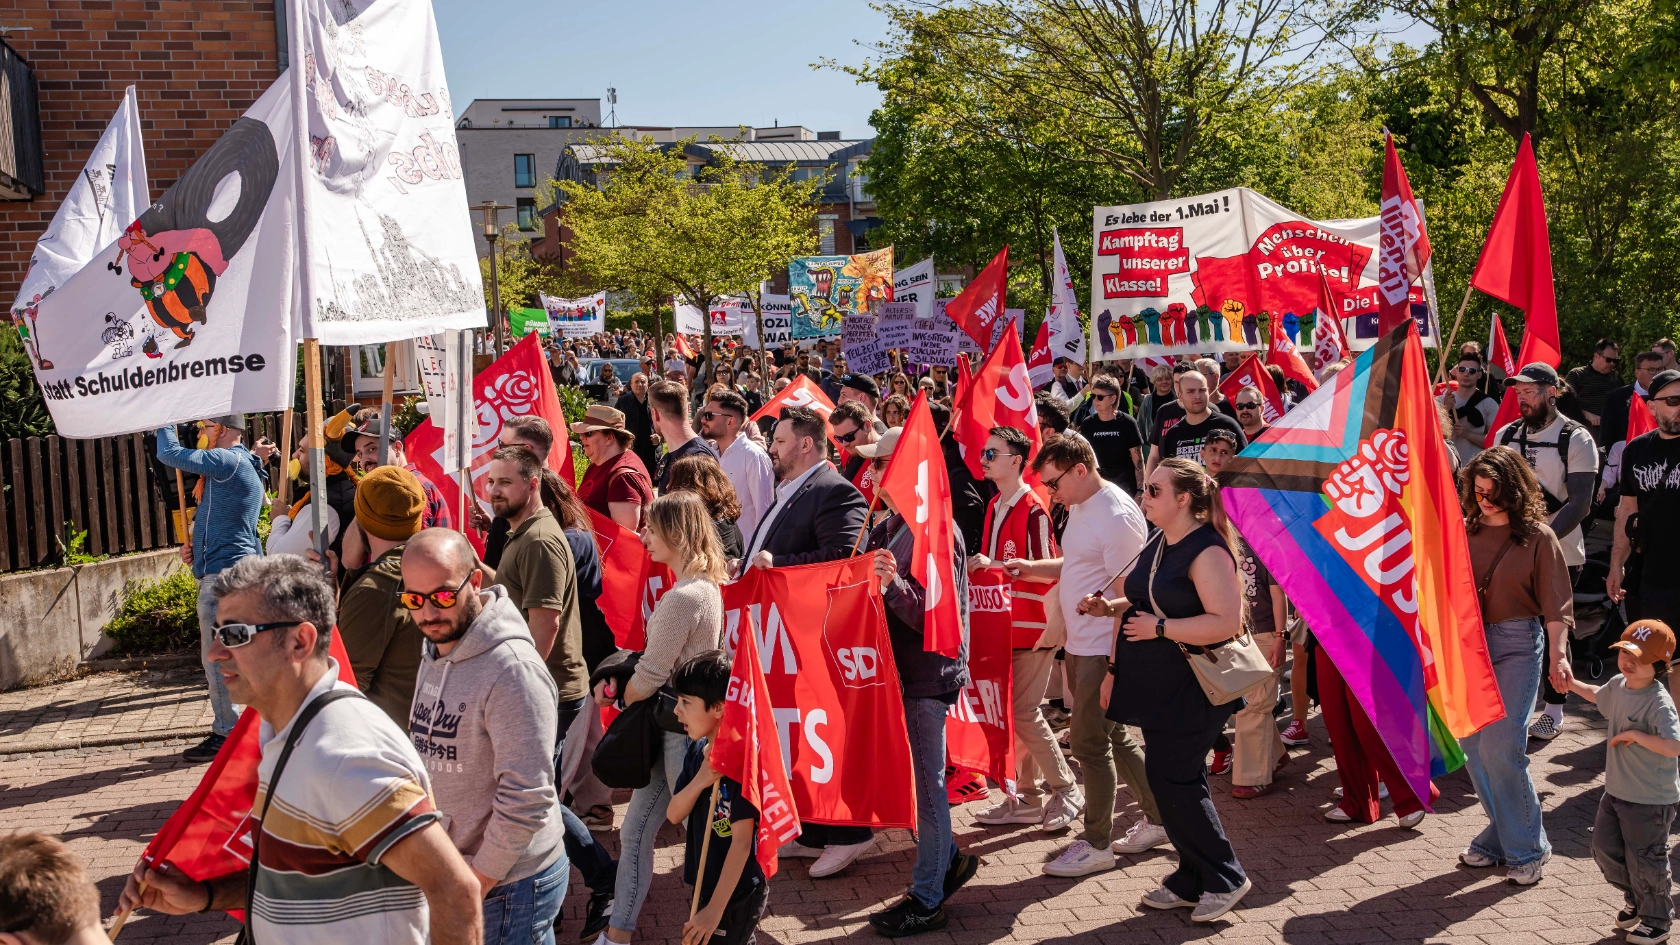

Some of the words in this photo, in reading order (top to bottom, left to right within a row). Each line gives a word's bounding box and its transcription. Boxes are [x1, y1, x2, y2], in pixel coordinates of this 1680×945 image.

[1105, 215, 1119, 226] Es
[1121, 212, 1146, 224] lebe
[1150, 211, 1171, 222] der
[1102, 231, 1179, 252] Kampftag
[1257, 229, 1351, 256] Menschen
[1281, 245, 1326, 259] über
[1123, 256, 1186, 270] unserer
[910, 273, 928, 284] SEIN
[1106, 278, 1161, 292] Klasse!
[1344, 296, 1369, 312] Die
[912, 332, 954, 344] INVESTITION
[846, 339, 881, 361] TEILZEIT
[861, 354, 873, 364] IST
[75, 353, 266, 397] Schuldenbremse
[1632, 625, 1652, 641] NY
